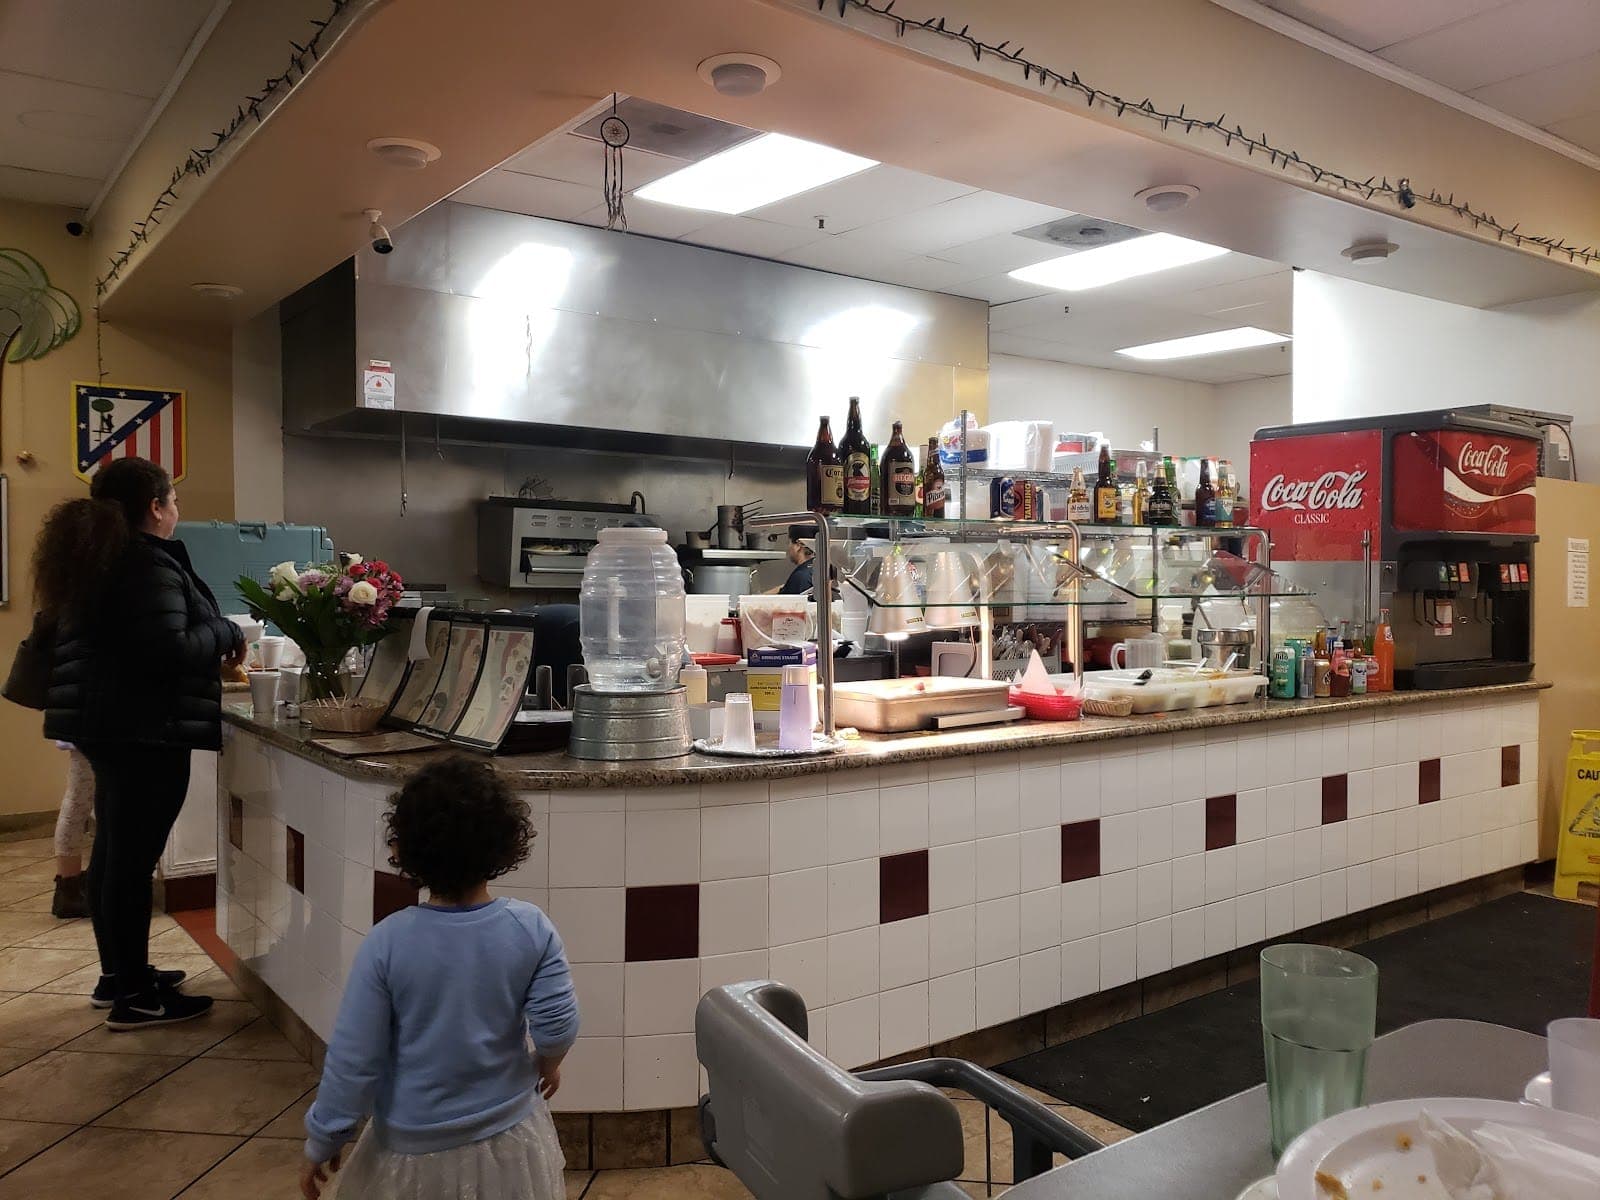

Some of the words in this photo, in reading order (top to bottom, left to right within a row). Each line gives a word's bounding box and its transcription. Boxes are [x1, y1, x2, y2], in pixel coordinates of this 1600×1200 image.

[1458, 441, 1511, 477] Coca-Cola
[1261, 470, 1367, 511] Coca-Cola
[1294, 513, 1330, 525] CLASSIC
